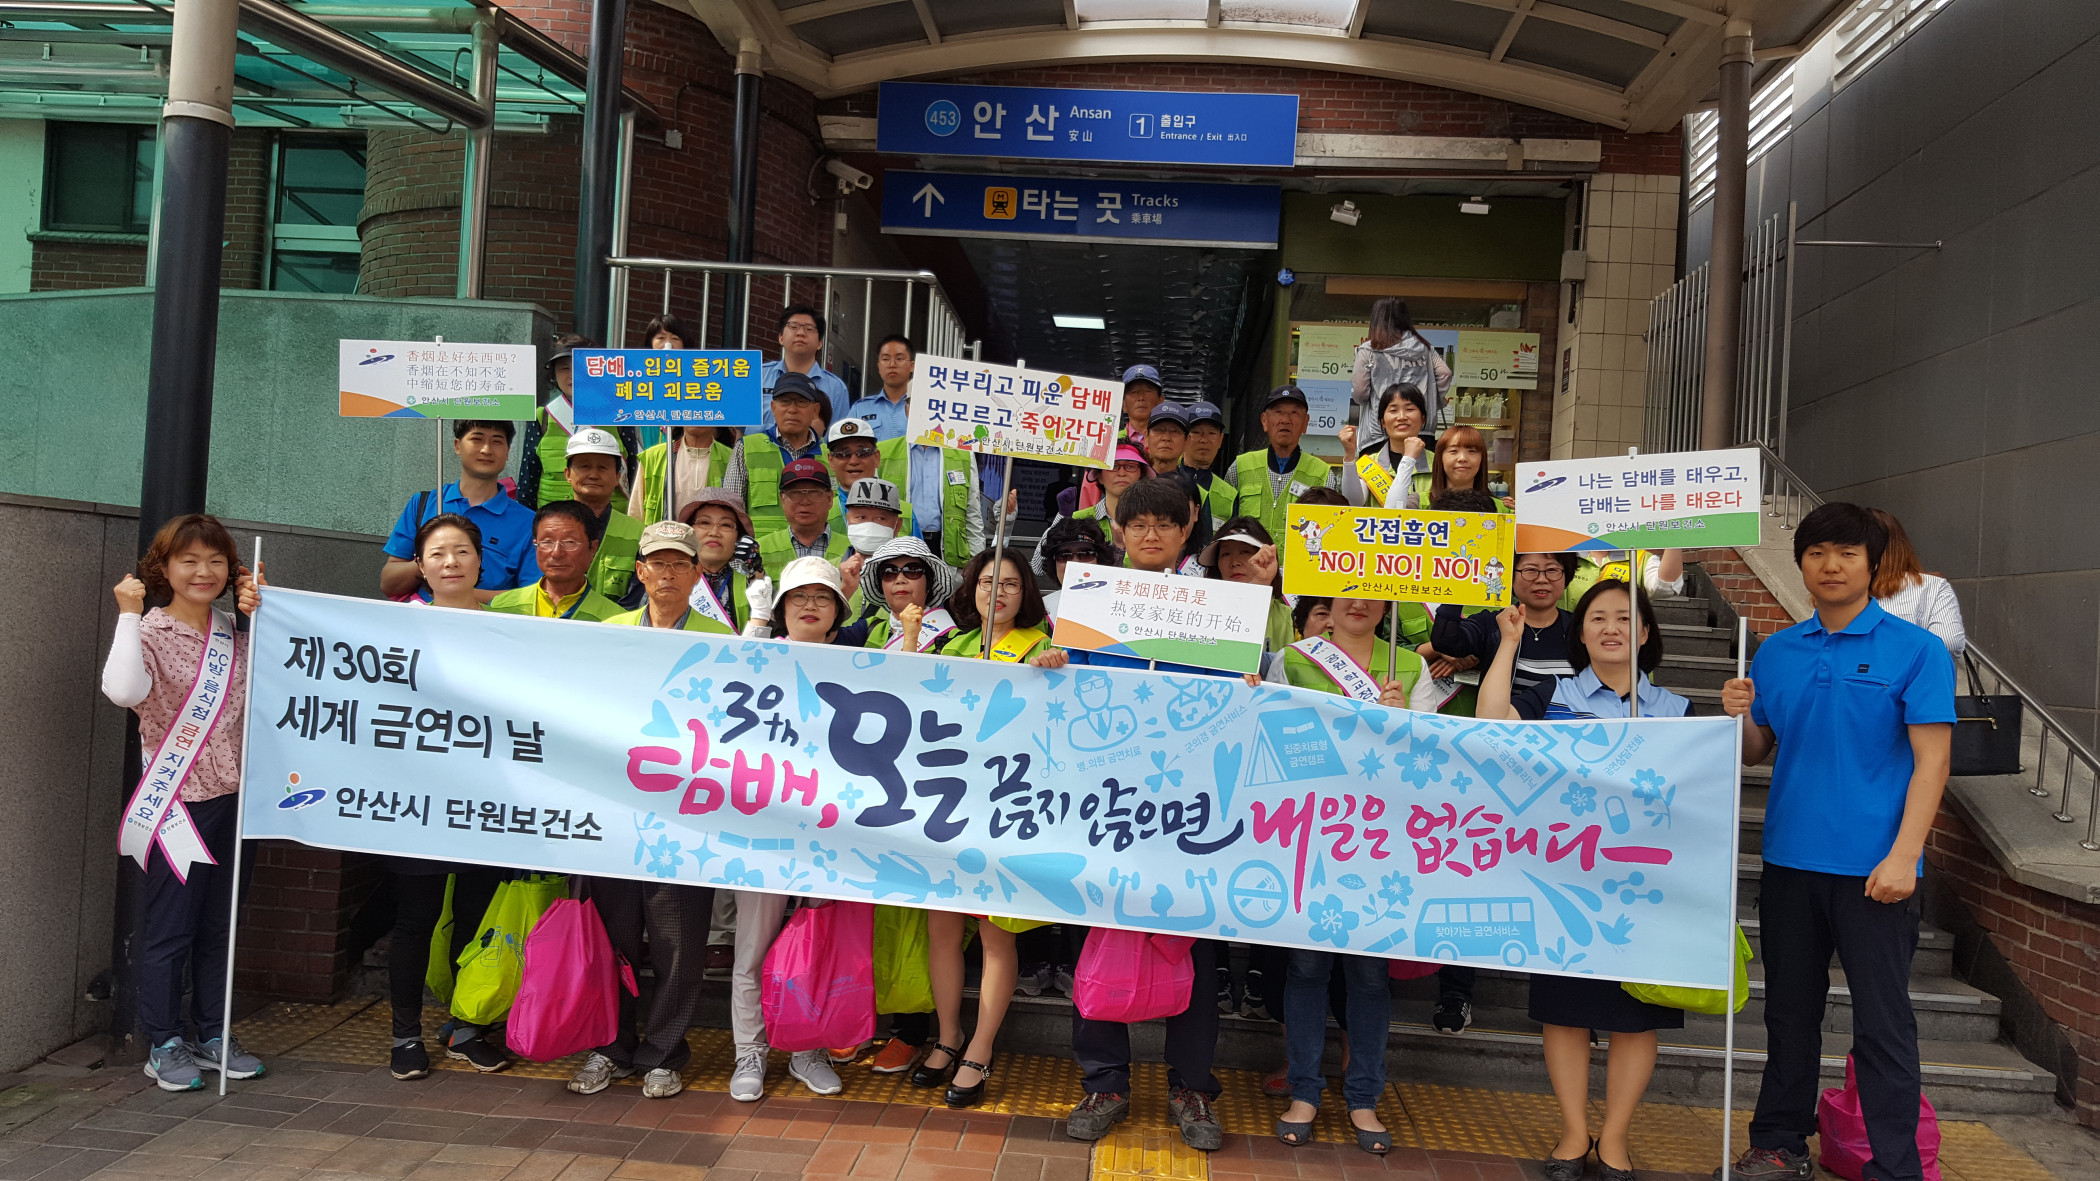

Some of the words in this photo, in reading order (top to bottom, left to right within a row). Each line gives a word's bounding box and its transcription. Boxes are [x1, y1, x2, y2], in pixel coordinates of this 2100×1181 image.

[930, 111, 956, 126] 453
[1069, 105, 1112, 120] Ansan
[1160, 114, 1197, 129] 출입구
[1135, 117, 1146, 135] 1
[1160, 131, 1198, 141] Entrance
[1206, 132, 1222, 142] Exit
[1022, 189, 1079, 221] 타는
[1096, 192, 1123, 224] 곳
[1132, 193, 1179, 208] Tracks
[406, 364, 507, 379] 香烟在不知不觉
[692, 357, 751, 379] 즐거움
[615, 381, 654, 401] 폐의
[663, 381, 723, 401] 괴로움
[929, 365, 1014, 397] 멋부리고
[1021, 379, 1063, 407] 피운
[1070, 385, 1112, 414] 담배
[421, 396, 450, 406] 안산시
[453, 397, 500, 407] 단원보건소
[633, 410, 667, 421] 안산시
[670, 410, 725, 421] 단원보건소
[927, 398, 1013, 428] 멋모르고
[1020, 411, 1106, 445] 죽어간다
[981, 436, 1012, 450] 안산시
[1015, 441, 1064, 456] 단원보건소
[1578, 472, 1614, 490] 나는
[1622, 468, 1677, 488] 담배를
[1686, 465, 1748, 484] 태우고,
[1578, 496, 1632, 515] 담배는
[1640, 493, 1677, 511] 나를
[1686, 490, 1743, 509] 태운다
[1353, 517, 1450, 547] 간접흡연
[1605, 521, 1640, 533] 안산시
[1646, 519, 1706, 531] 단원보건소
[1319, 551, 1366, 577] NO!
[1376, 554, 1422, 580] NO!
[1432, 556, 1480, 584] NO!
[1114, 579, 1208, 606] 禁烟限酒是
[1361, 581, 1394, 593] 안산시
[1398, 584, 1454, 596] 단원보건소
[1133, 625, 1164, 638] 안산시
[1168, 630, 1218, 645] 단원보건소
[276, 695, 359, 745] 세계
[370, 702, 493, 759] 금연의
[506, 719, 545, 763] 날
[1208, 704, 1248, 736] 금연서비스
[174, 721, 201, 751] 금연
[1107, 745, 1143, 764] 금연치료
[1283, 740, 1328, 755] 집중치료형
[1602, 733, 1646, 776] 금연상담전화
[1290, 754, 1326, 768] 금연캠프
[135, 752, 185, 822] 지켜주세요
[815, 681, 970, 843] 오늘
[984, 753, 1071, 841] 끊지
[1079, 777, 1244, 856] 않으면
[1249, 791, 1391, 914] 내일은
[335, 786, 431, 827] 안산시
[445, 797, 604, 842] 단원보건소
[1435, 926, 1471, 938] 찾아가는
[1474, 925, 1521, 937] 금연서비스
